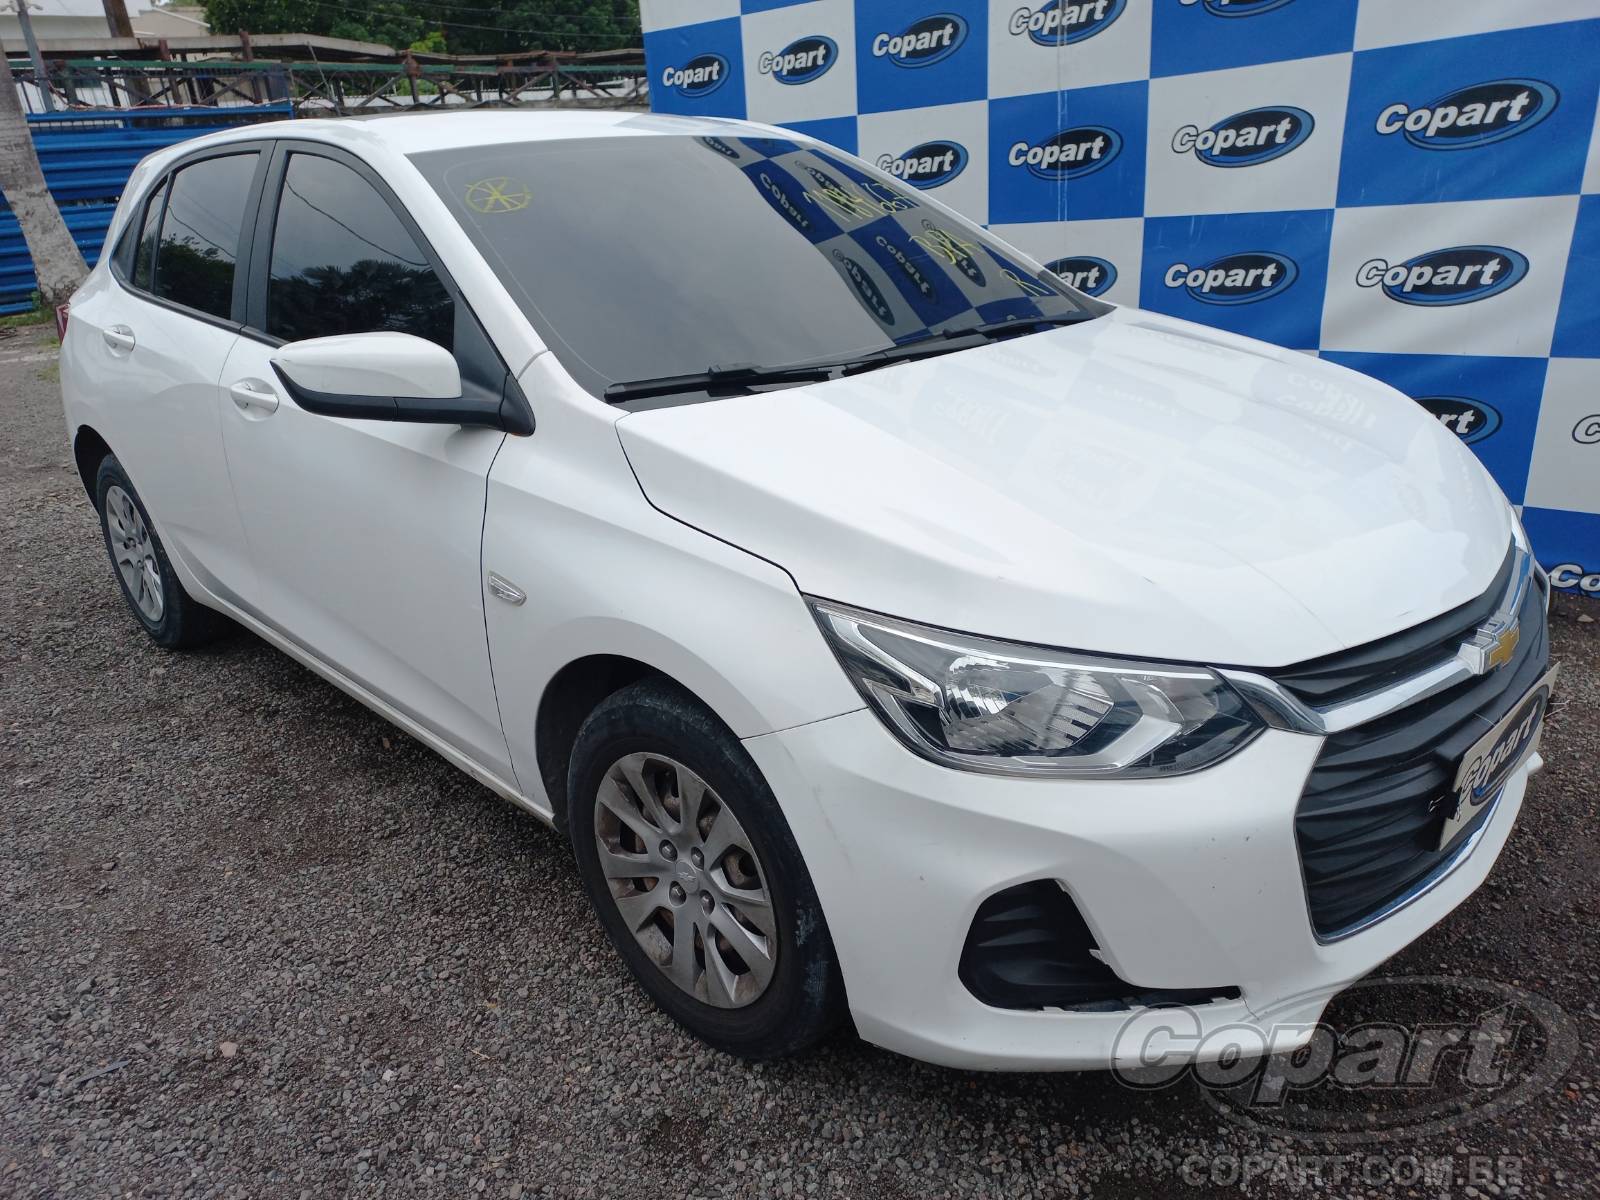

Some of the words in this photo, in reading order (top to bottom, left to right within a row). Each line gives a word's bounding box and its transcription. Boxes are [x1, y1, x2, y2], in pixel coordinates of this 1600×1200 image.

[1008, 0, 1108, 36] Copart
[872, 22, 955, 58] Copart
[662, 61, 720, 89] Copart
[758, 45, 826, 76] Copart
[1376, 90, 1531, 137] Copart
[1008, 132, 1105, 168] Copart
[1171, 117, 1292, 156] Copart
[876, 150, 954, 180] Copart
[1059, 266, 1099, 288] art
[1164, 262, 1278, 294] Copart
[1356, 257, 1501, 293] Copart
[1459, 700, 1539, 804] Copart
